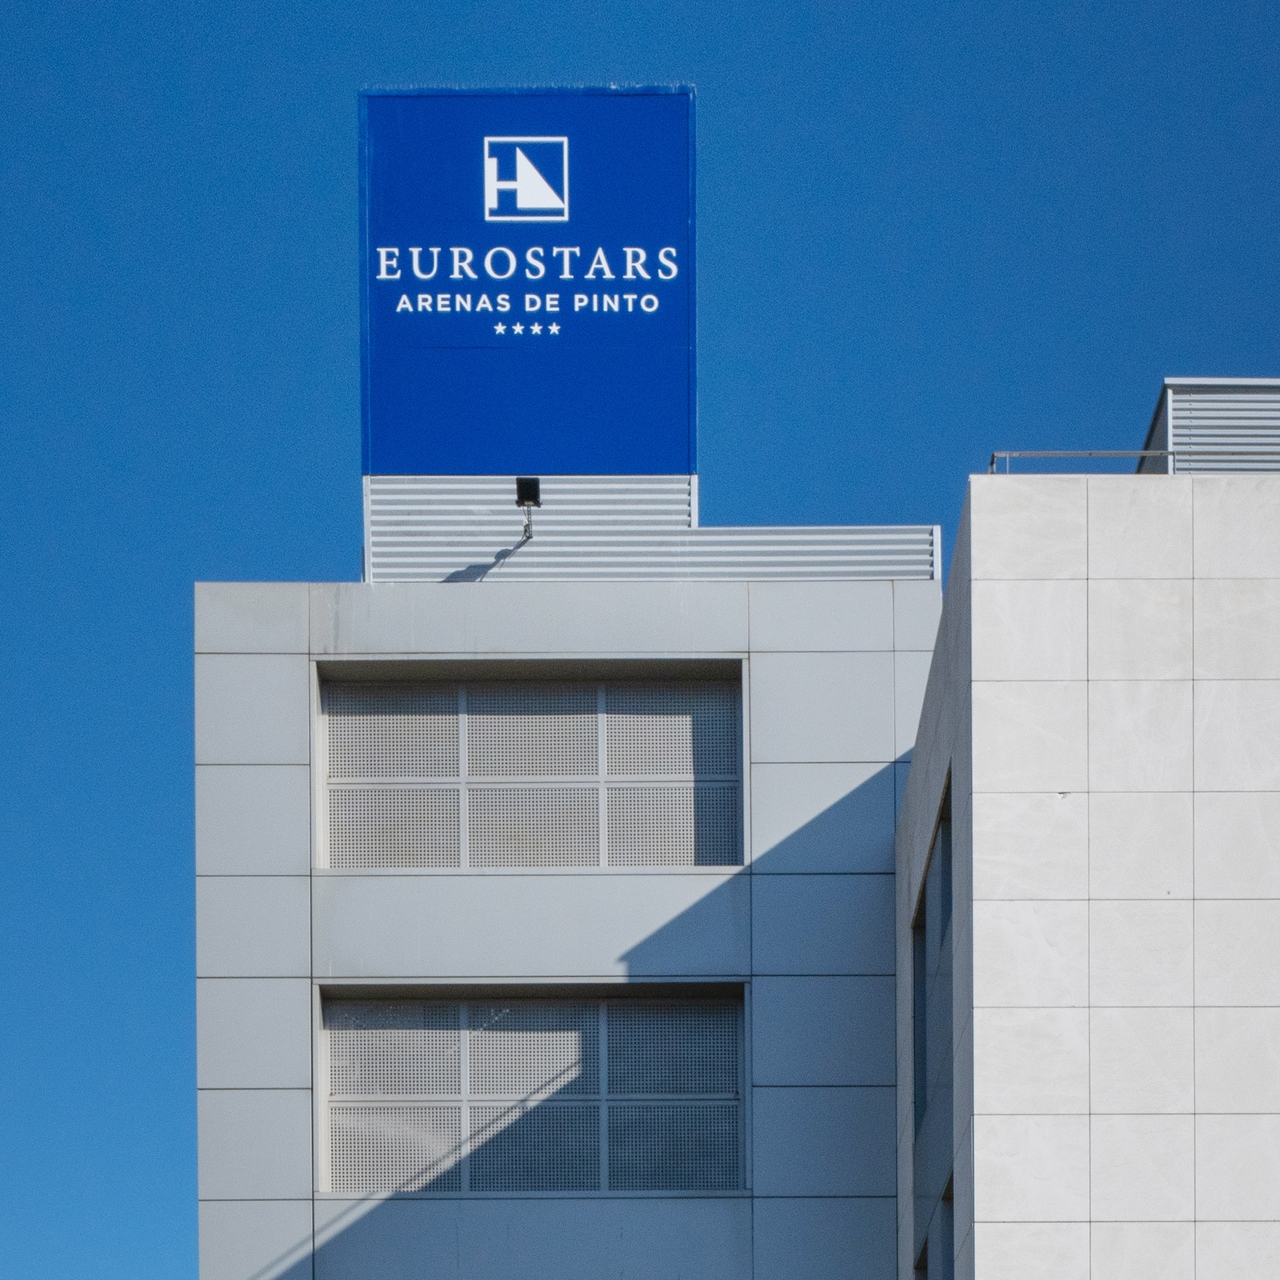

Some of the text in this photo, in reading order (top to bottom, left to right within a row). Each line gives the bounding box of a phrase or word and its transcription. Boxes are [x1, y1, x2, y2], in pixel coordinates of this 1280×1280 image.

[376, 247, 678, 279] EUROSTARS
[396, 294, 659, 312] ARENAS DE PINTO
